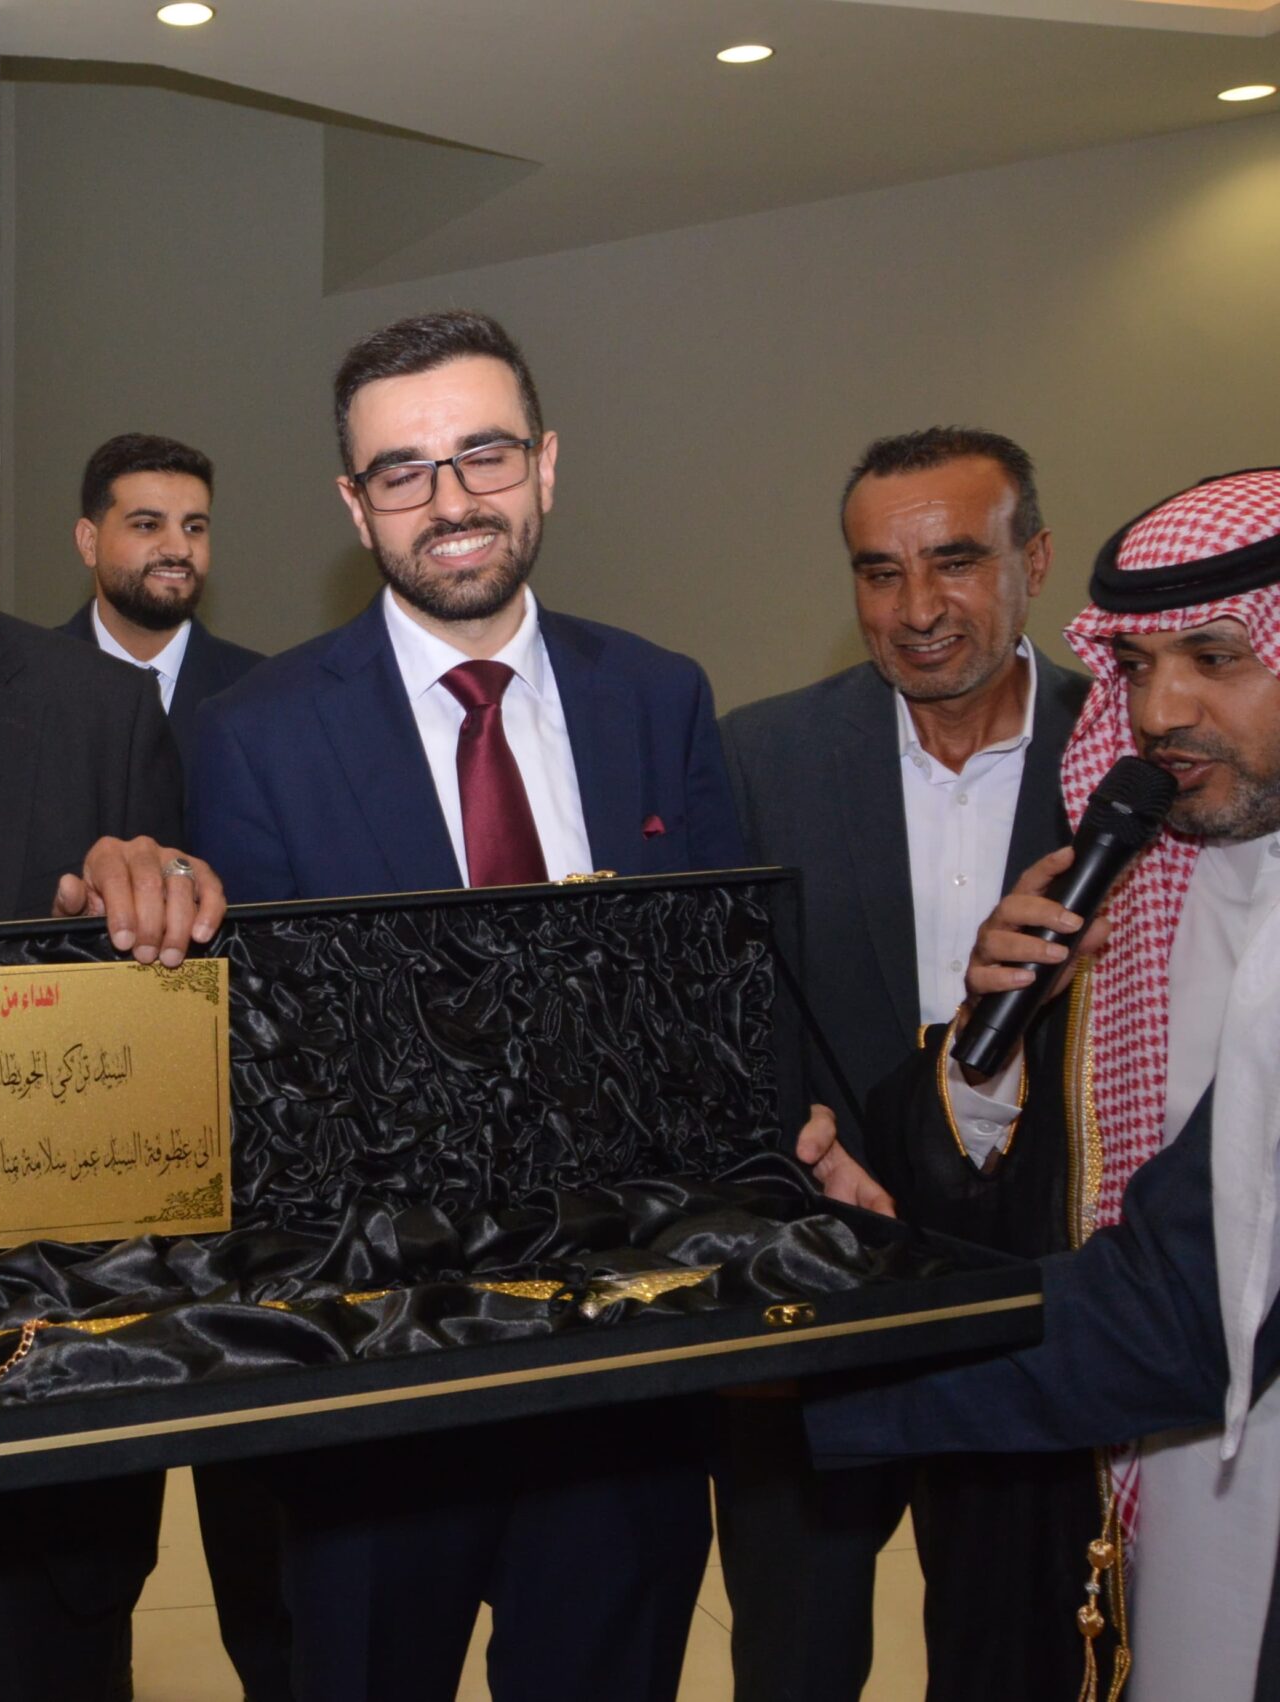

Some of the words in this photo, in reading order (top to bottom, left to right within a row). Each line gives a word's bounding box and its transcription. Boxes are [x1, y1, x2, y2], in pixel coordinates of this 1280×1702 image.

[22, 983, 60, 1009] اهداء
[51, 1043, 89, 1104] تركي
[94, 1046, 133, 1090] السيد
[22, 1136, 66, 1176] سلامة
[70, 1150, 100, 1182] عمر
[103, 1131, 141, 1176] السيد
[145, 1128, 191, 1177] عطوفة
